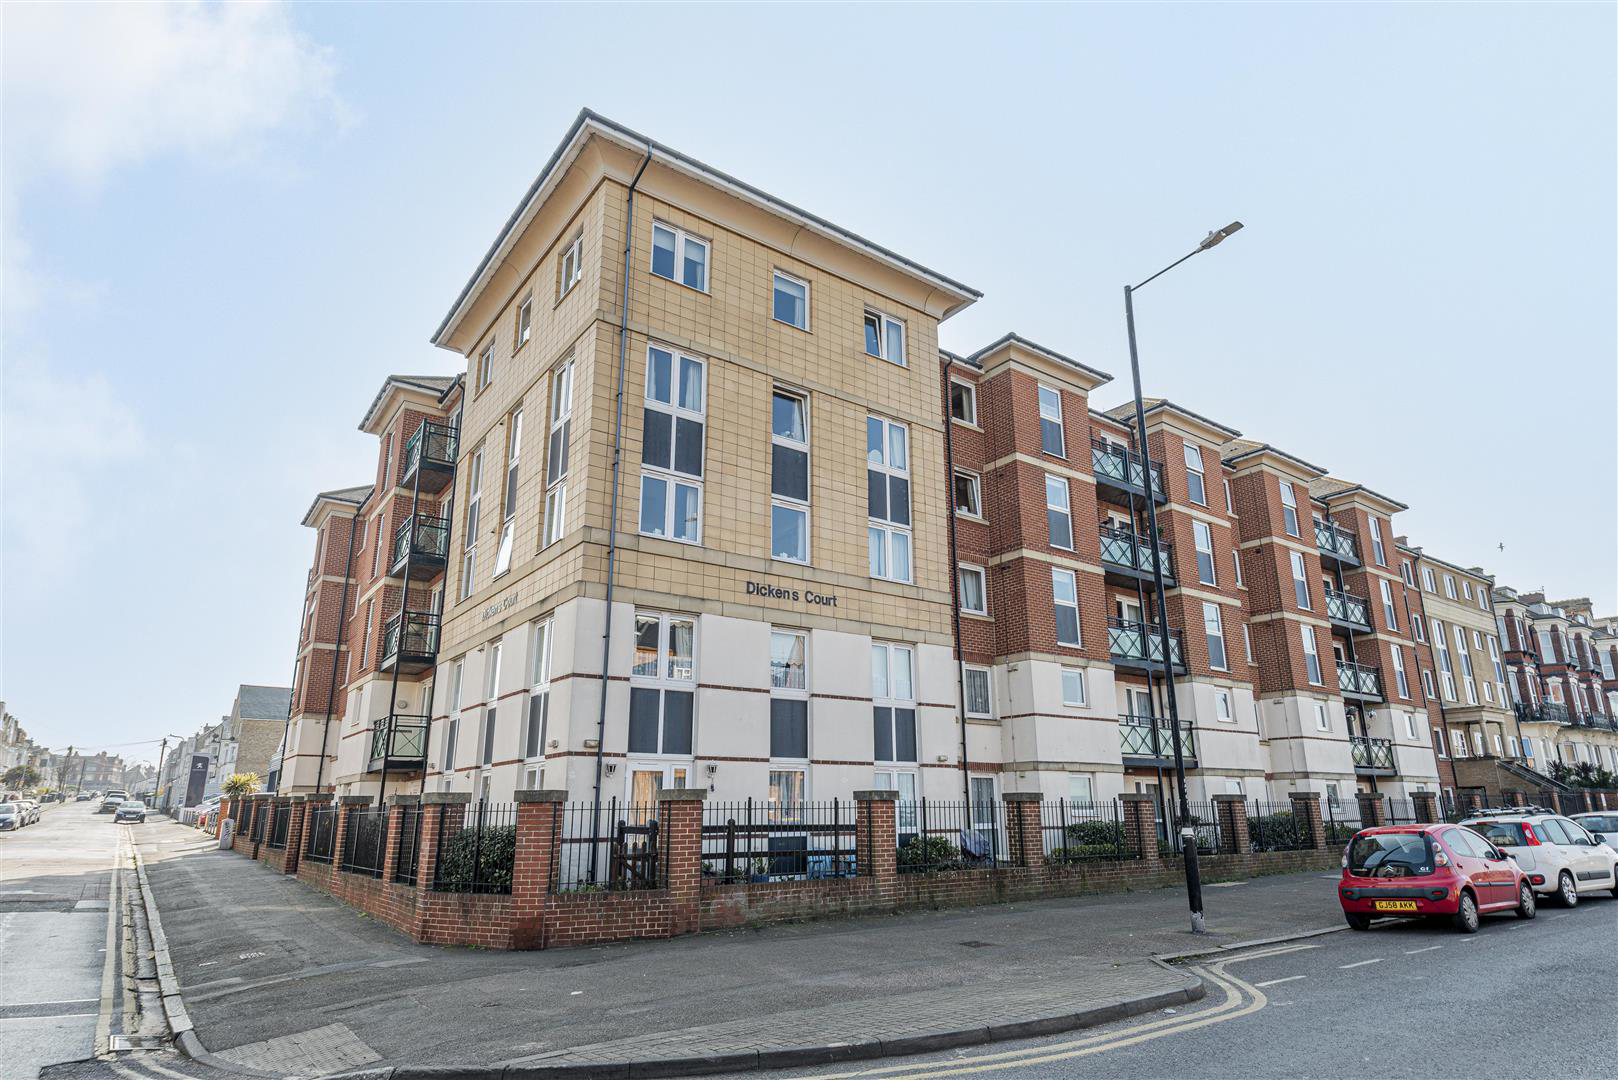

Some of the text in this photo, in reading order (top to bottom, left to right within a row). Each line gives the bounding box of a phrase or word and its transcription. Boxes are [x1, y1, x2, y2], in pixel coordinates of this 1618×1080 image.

[746, 581, 838, 607] Dickens Court
[1378, 901, 1414, 909] GJ58 AKK
